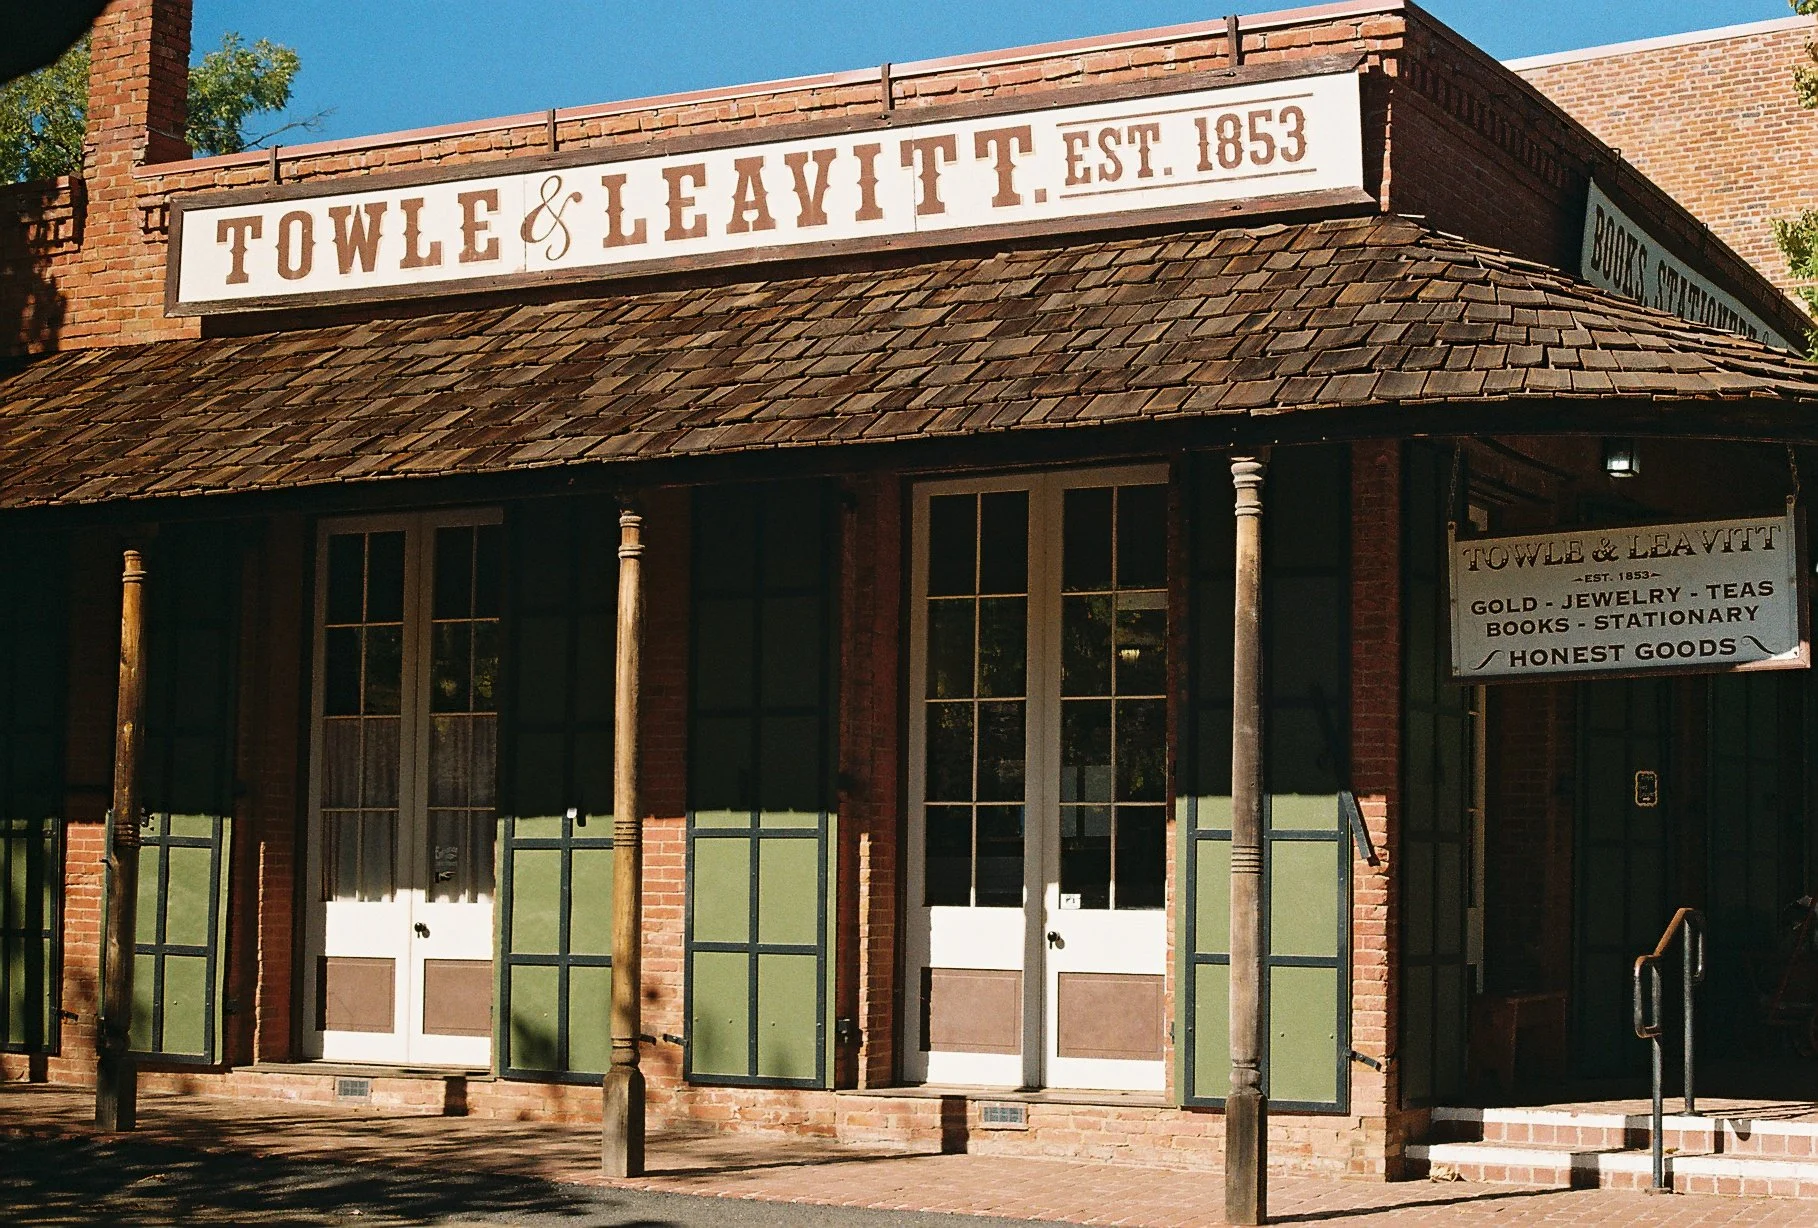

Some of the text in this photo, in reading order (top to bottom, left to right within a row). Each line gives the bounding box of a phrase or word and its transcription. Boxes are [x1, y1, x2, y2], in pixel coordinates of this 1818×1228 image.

[216, 105, 1308, 286] TOWLE & LEAVITT. EST. 1853
[1462, 524, 1782, 573] TOWLE & LEAVITT
[1584, 571, 1650, 583] EST. 1853
[1470, 597, 1538, 616] GOLD
[1561, 587, 1682, 611] JEWELRY
[1706, 580, 1775, 600] TEAS
[1486, 618, 1570, 638] BOOKS
[1593, 606, 1760, 631] STATIONARY
[1509, 638, 1737, 668] HONEST GOODS
